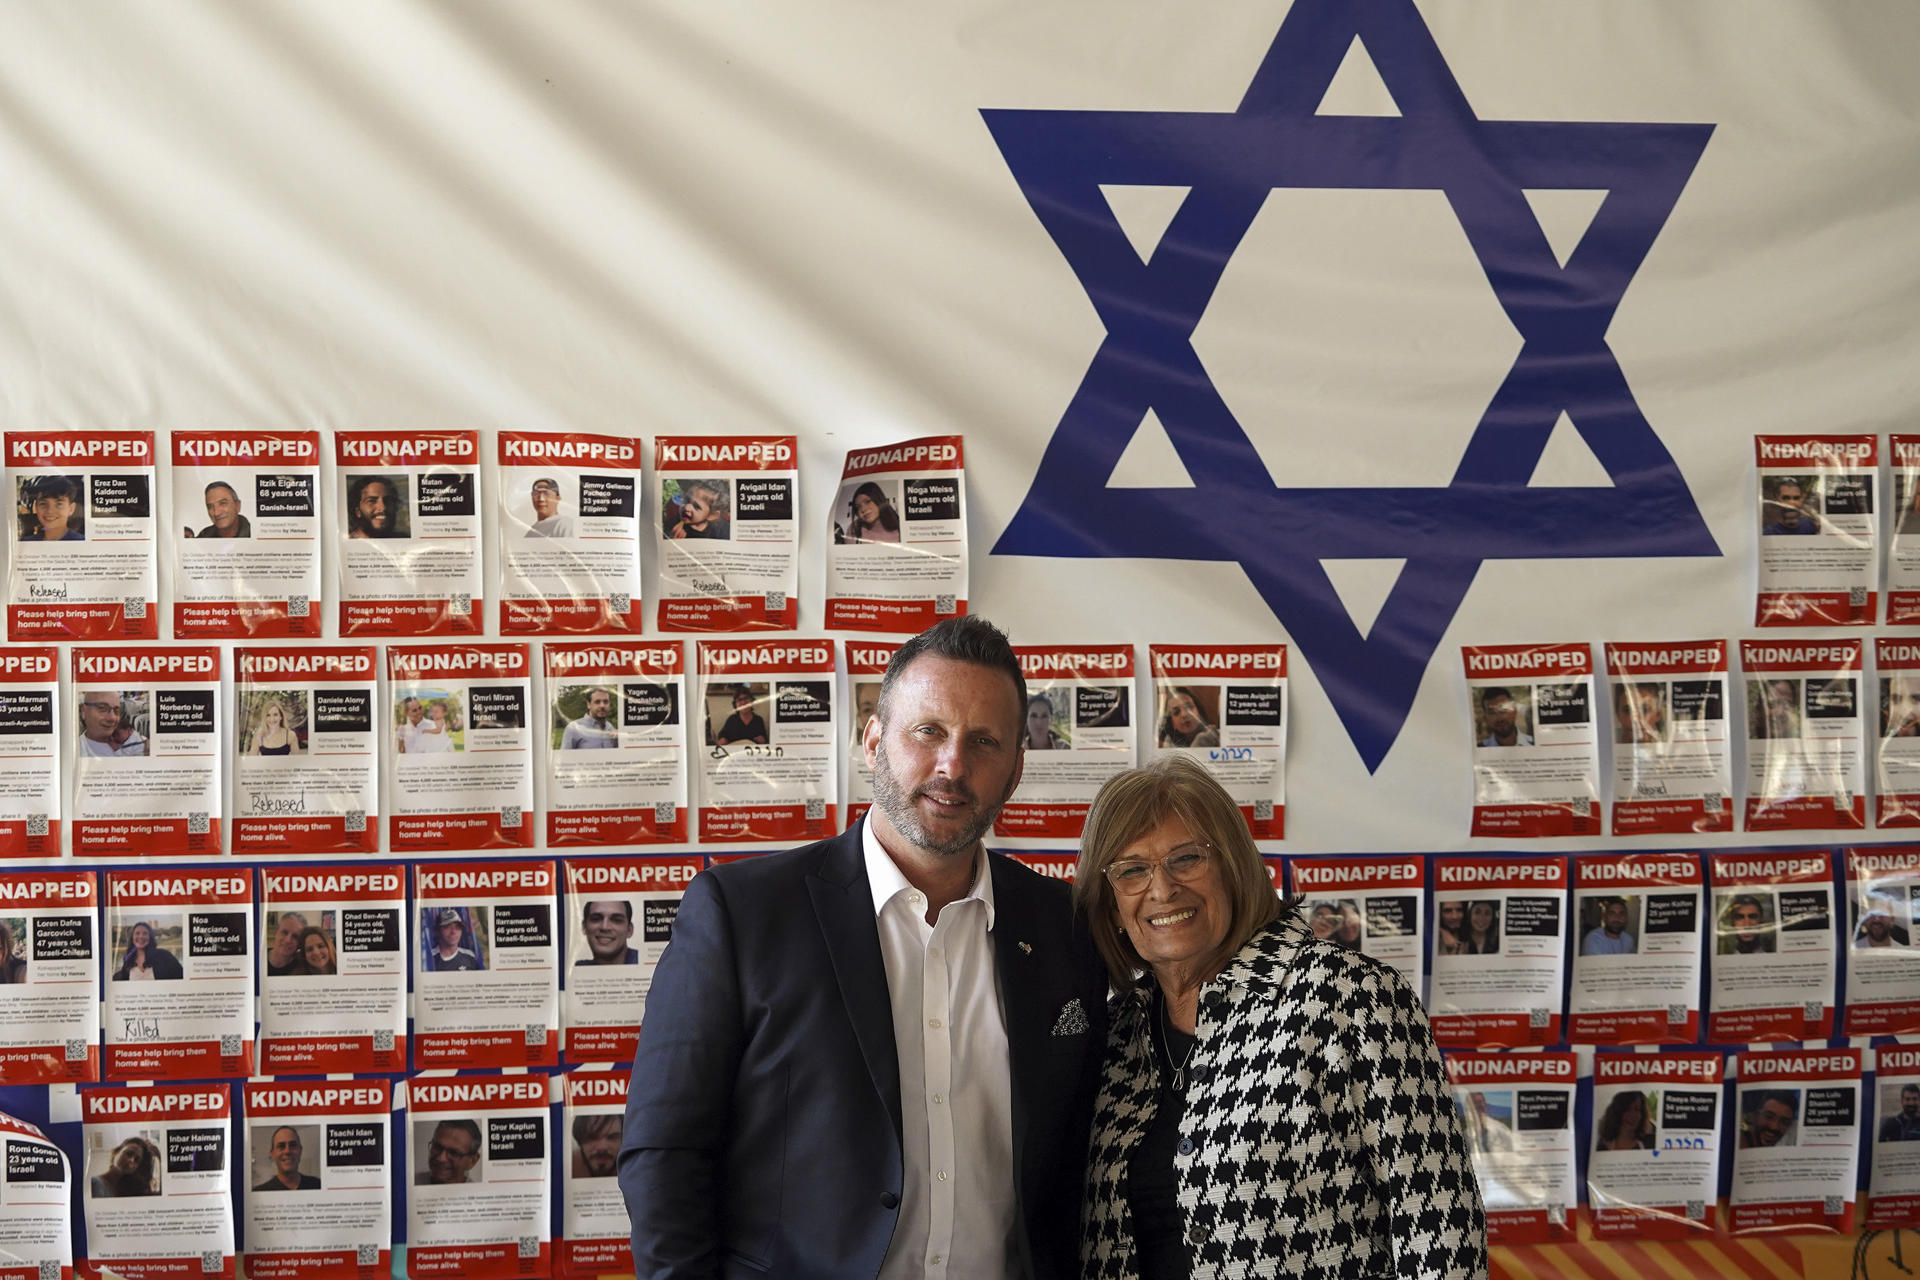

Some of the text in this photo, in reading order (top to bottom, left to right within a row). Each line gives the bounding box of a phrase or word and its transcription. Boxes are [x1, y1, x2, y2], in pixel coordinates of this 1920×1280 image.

[12, 440, 148, 458] KIDNAPPED
[180, 439, 313, 457] KIDNAPPED
[342, 439, 473, 457] KIDNAPPED
[505, 440, 634, 460] KIDNAPPED
[663, 445, 791, 462] KIDNAPPED
[1761, 443, 1871, 459] KIDNAPPED
[848, 444, 957, 471] KIDNAPPED
[111, 479, 127, 487] Dan
[421, 477, 443, 486] Matan
[582, 481, 605, 492] Jimmy
[94, 488, 128, 496] Kalderon
[270, 490, 294, 499] years
[294, 488, 310, 499] old
[739, 483, 787, 493] Avigail Idan
[907, 485, 955, 496] Noga Weiss
[95, 496, 138, 506] 12 years old
[430, 495, 464, 504] years old
[583, 497, 592, 507] 33
[591, 498, 611, 507] years
[740, 492, 784, 503] 3 years old
[908, 493, 956, 505] 18 years old
[94, 505, 118, 513] Israeli
[421, 504, 444, 512] Israeli
[740, 502, 765, 511] Israeli
[908, 505, 933, 514] Israeli
[550, 649, 677, 668] KIDNAPPED
[704, 648, 828, 666] KIDNAPPED
[1608, 648, 1720, 667] KIDNAPPED
[1745, 646, 1857, 663] KIDNAPPED
[78, 656, 213, 673] KIDNAPPED
[239, 656, 370, 673] KIDNAPPED
[395, 653, 523, 671] KIDNAPPED
[1157, 653, 1280, 669] KIDNAPPED
[1469, 651, 1586, 671] KIDNAPPED
[159, 695, 176, 703] Luis
[472, 693, 515, 702] Omri Miran
[317, 705, 327, 713] 43
[327, 706, 348, 714] years
[483, 704, 505, 713] years
[506, 703, 520, 711] old
[169, 713, 190, 722] years
[190, 712, 203, 720] old
[473, 713, 497, 723] Israeli
[159, 719, 177, 727] Israeli
[251, 788, 305, 813] Released
[81, 825, 174, 835] Please help bring them
[81, 835, 128, 844] home alive.
[1849, 854, 1920, 871] KIDNAP
[1299, 864, 1418, 883] KIDNAPPED
[1441, 865, 1561, 882] KIDNAPPED
[1581, 862, 1695, 880] KIDNAPPED
[1715, 859, 1826, 878] KIDNAPPED
[571, 865, 697, 884] KIDNAPPED
[112, 877, 246, 897] KIDNAPPED
[267, 875, 398, 894] KIDNAPPED
[420, 872, 549, 891] KIDNAPPED
[0, 881, 91, 899] NAPPED
[36, 919, 82, 928] Loren Dafna
[192, 916, 209, 924] Noa
[36, 929, 75, 938] Garcovich
[192, 925, 229, 934] Marciano
[505, 927, 526, 935] years
[36, 938, 82, 949] 47 years old
[193, 933, 240, 945] 19 years old
[192, 944, 218, 953] Israeli
[125, 1018, 160, 1039] Killed
[114, 1048, 207, 1058] Please help bring them
[115, 1059, 161, 1068] home alive.
[1453, 1059, 1571, 1076] KIDNAPPED
[1600, 1059, 1717, 1077] KIDNAPPED
[1743, 1056, 1856, 1075] KIDNAPPED
[251, 1088, 383, 1108] KIDNAPPED
[413, 1083, 543, 1103] KIDNAPPED
[90, 1093, 224, 1114] KIDNAPPED
[329, 1128, 373, 1138] Tsachi Idan
[501, 1133, 523, 1142] years
[523, 1131, 537, 1140] old
[169, 1142, 218, 1154] 27 years old
[329, 1137, 376, 1148] 51 years old
[490, 1142, 515, 1151] Israeli
[8, 1144, 60, 1156] Romi Gonen
[328, 1146, 353, 1157] Israeli
[8, 1154, 59, 1165] 23 years old
[169, 1153, 195, 1162] Israeli
[9, 1165, 36, 1174] Israeli
